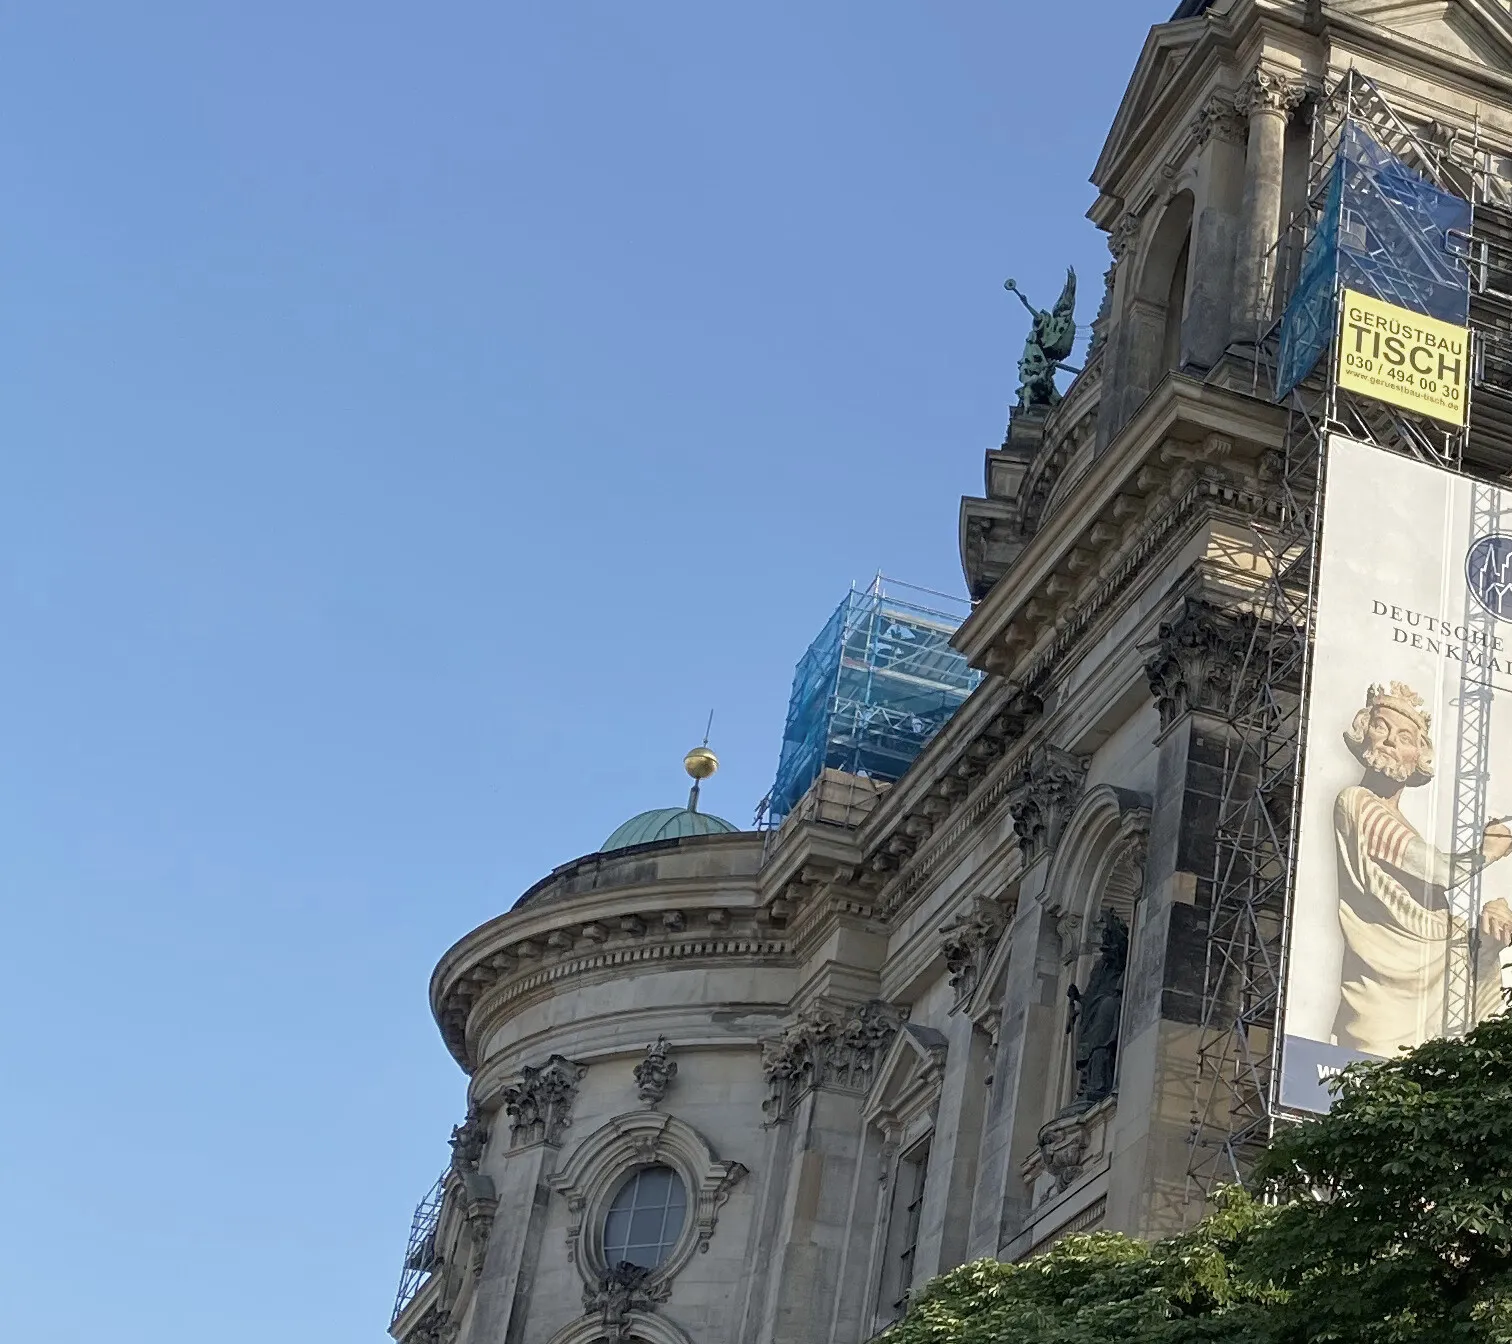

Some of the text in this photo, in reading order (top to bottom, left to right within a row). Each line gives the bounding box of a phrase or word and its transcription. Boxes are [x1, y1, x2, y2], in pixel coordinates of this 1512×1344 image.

[1348, 322, 1461, 386] TISCH
[1349, 307, 1462, 356] GERÜSTBAU
[1345, 368, 1459, 412] www.geruestbau-tisch.de
[1346, 353, 1373, 372] 030
[1387, 367, 1415, 386] 494
[1419, 377, 1437, 393] 00
[1441, 384, 1459, 401] 30
[1371, 599, 1505, 653] DEUTSCHE
